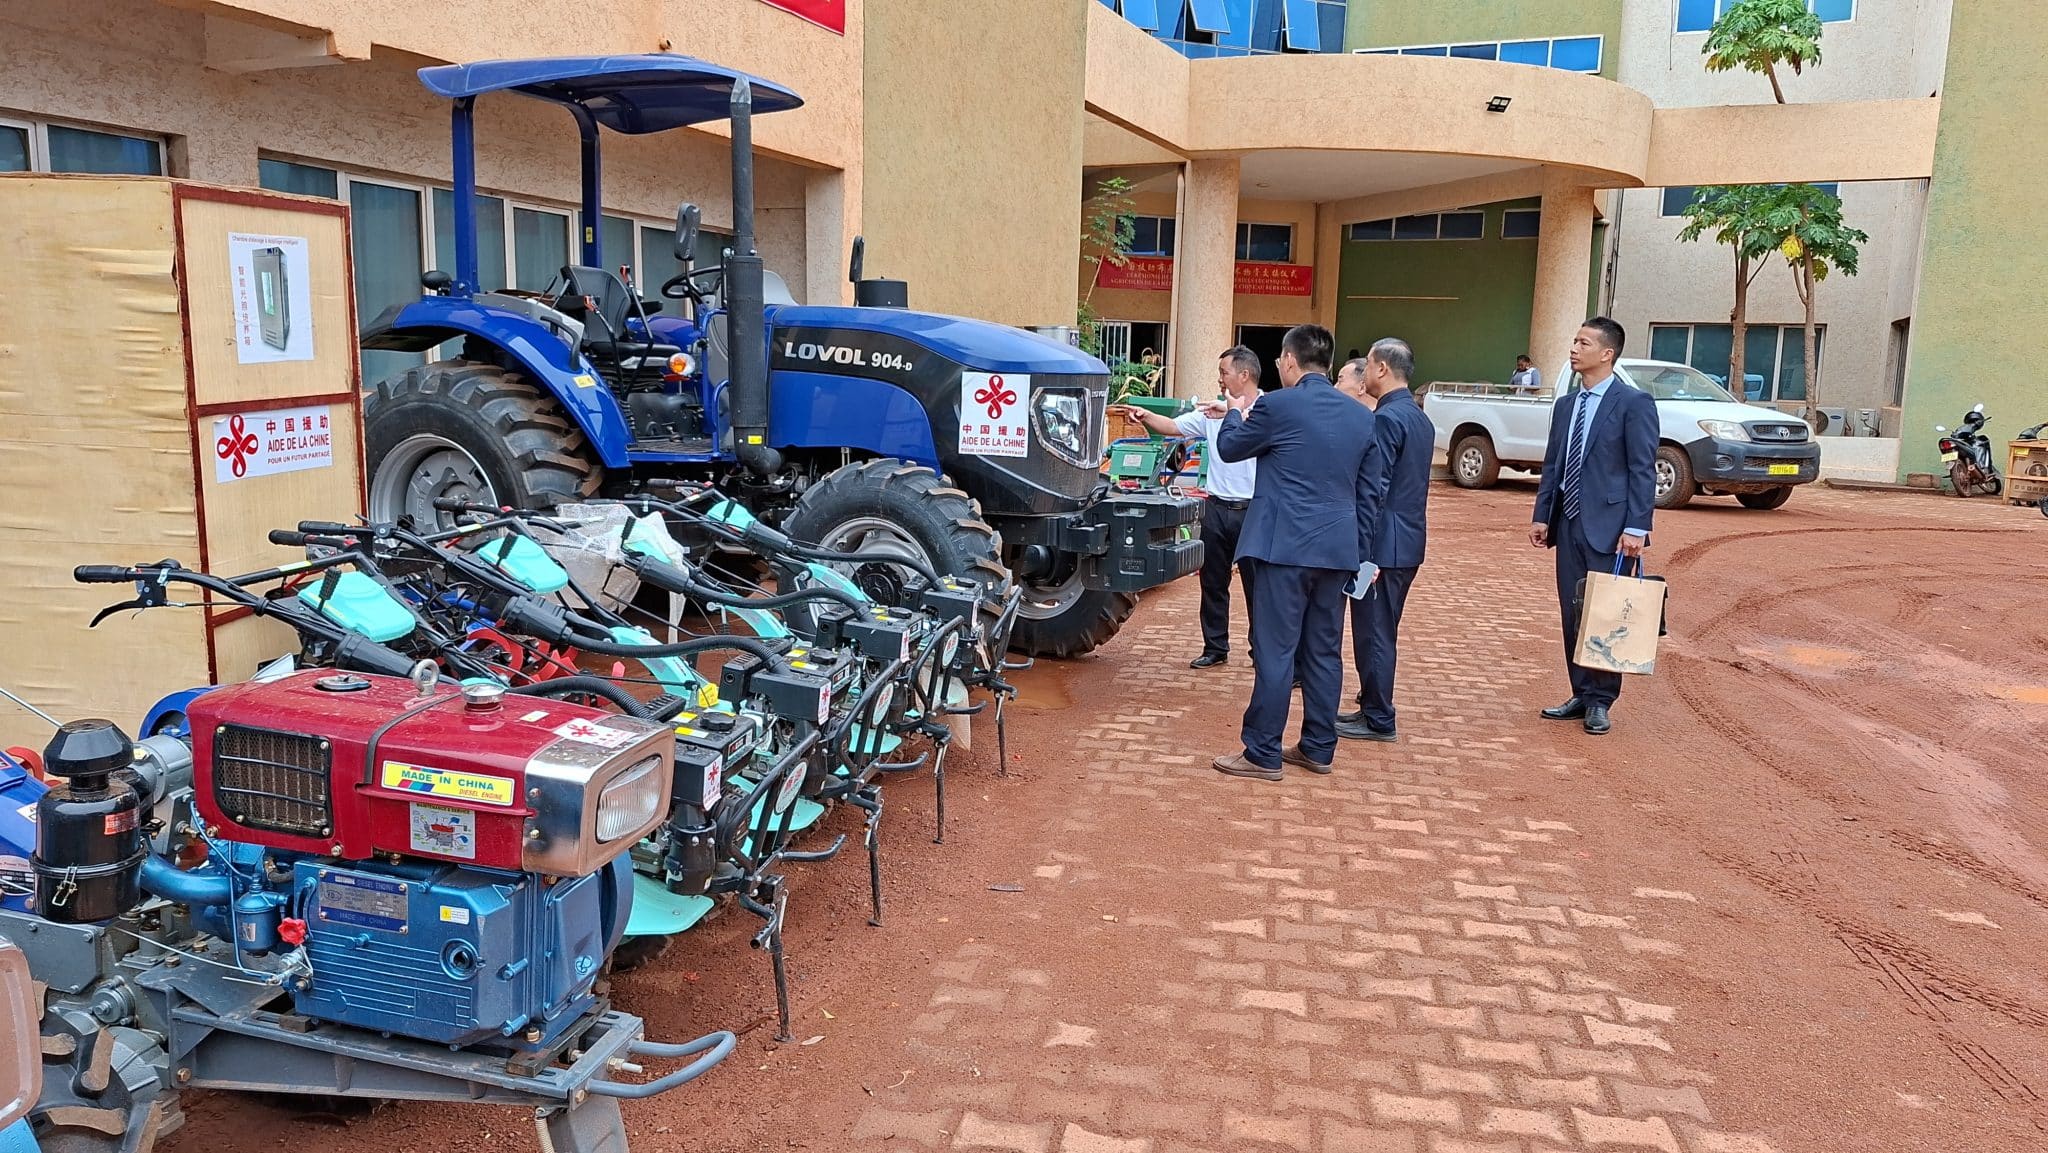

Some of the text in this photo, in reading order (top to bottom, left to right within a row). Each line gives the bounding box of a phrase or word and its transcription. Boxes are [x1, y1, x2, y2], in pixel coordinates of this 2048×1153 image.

[784, 341, 866, 366] LOVOL
[266, 414, 329, 435] 中国援助
[962, 423, 1026, 437] 中国援助
[267, 433, 330, 453] AIDE DE LA CHINE
[961, 436, 1025, 448] AIDE DE LA CHINE
[267, 456, 282, 465] POUR
[283, 455, 291, 463] UN
[291, 453, 308, 462] FUTUR
[401, 770, 494, 791] MADE IN CHINA
[459, 788, 503, 800] DIESEL ENGINE
